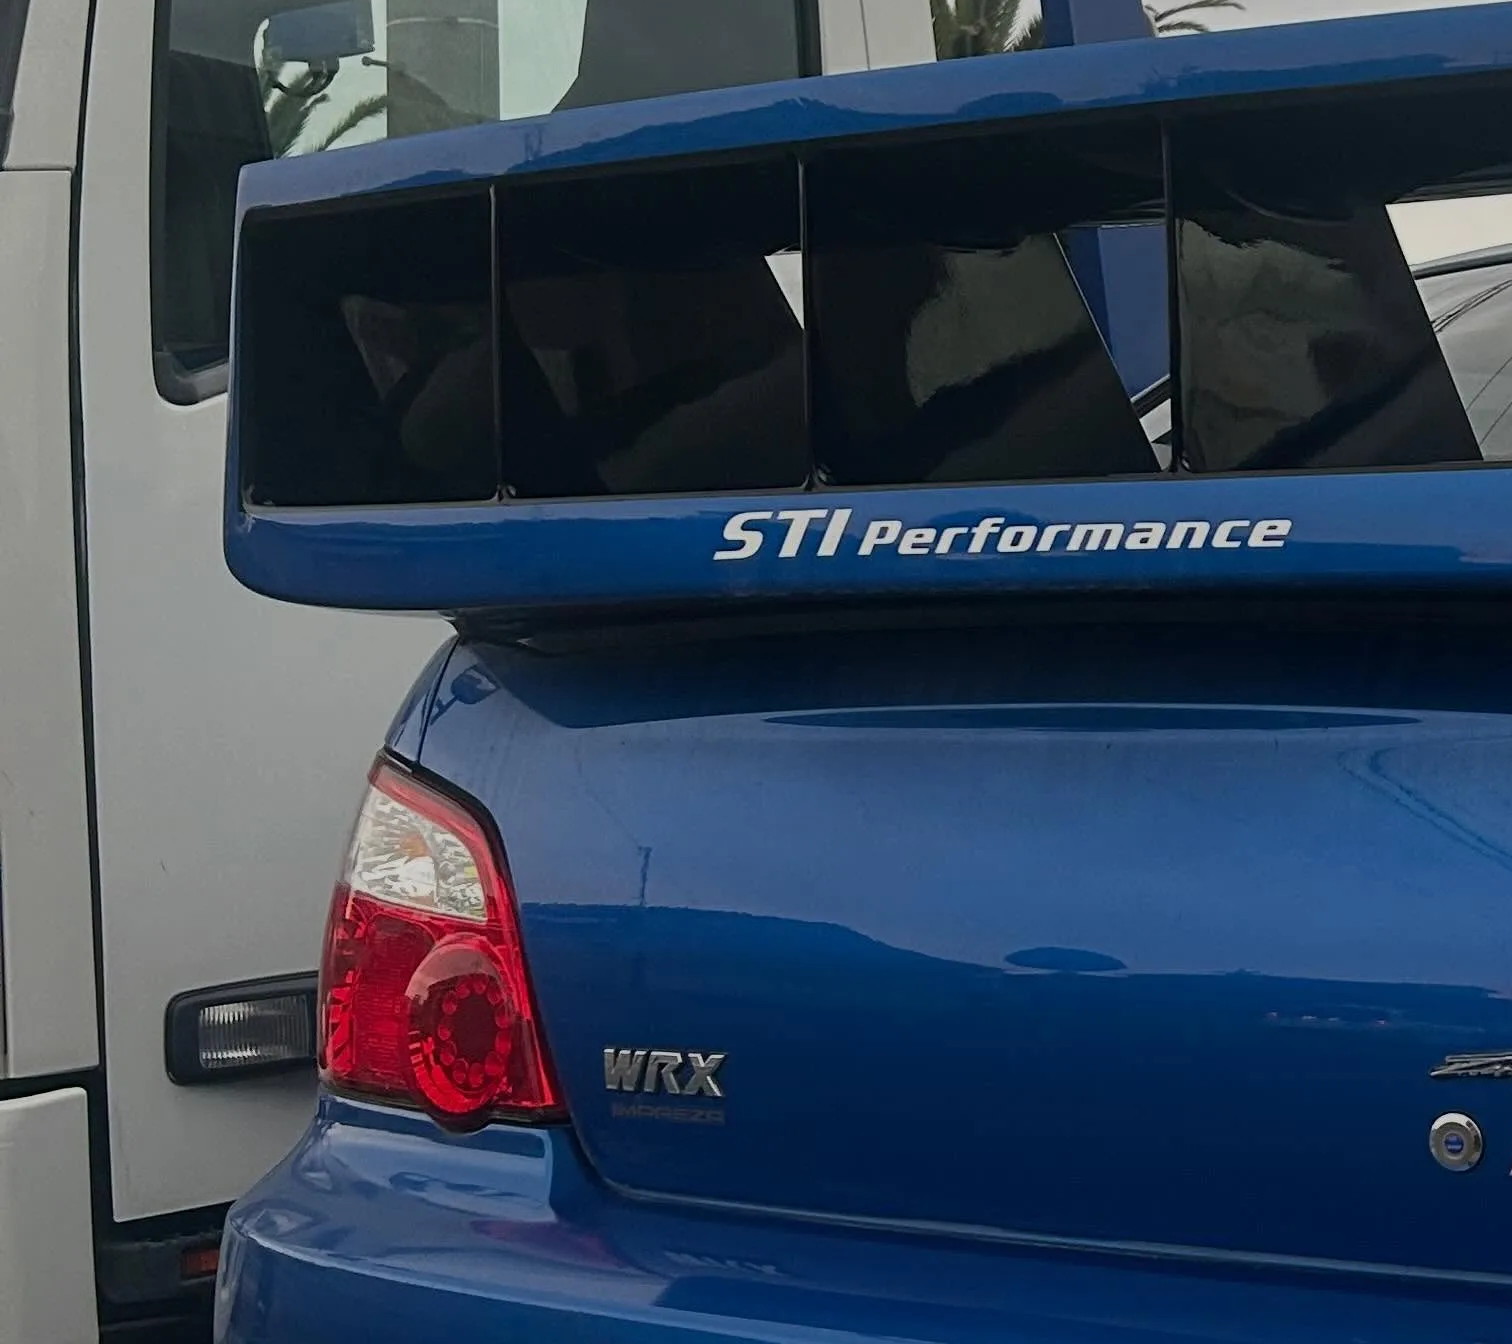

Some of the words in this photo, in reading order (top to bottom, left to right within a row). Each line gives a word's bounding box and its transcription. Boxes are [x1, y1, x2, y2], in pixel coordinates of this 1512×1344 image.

[712, 508, 853, 561] STI
[857, 516, 1293, 556] Performance
[603, 1048, 727, 1097] WRX
